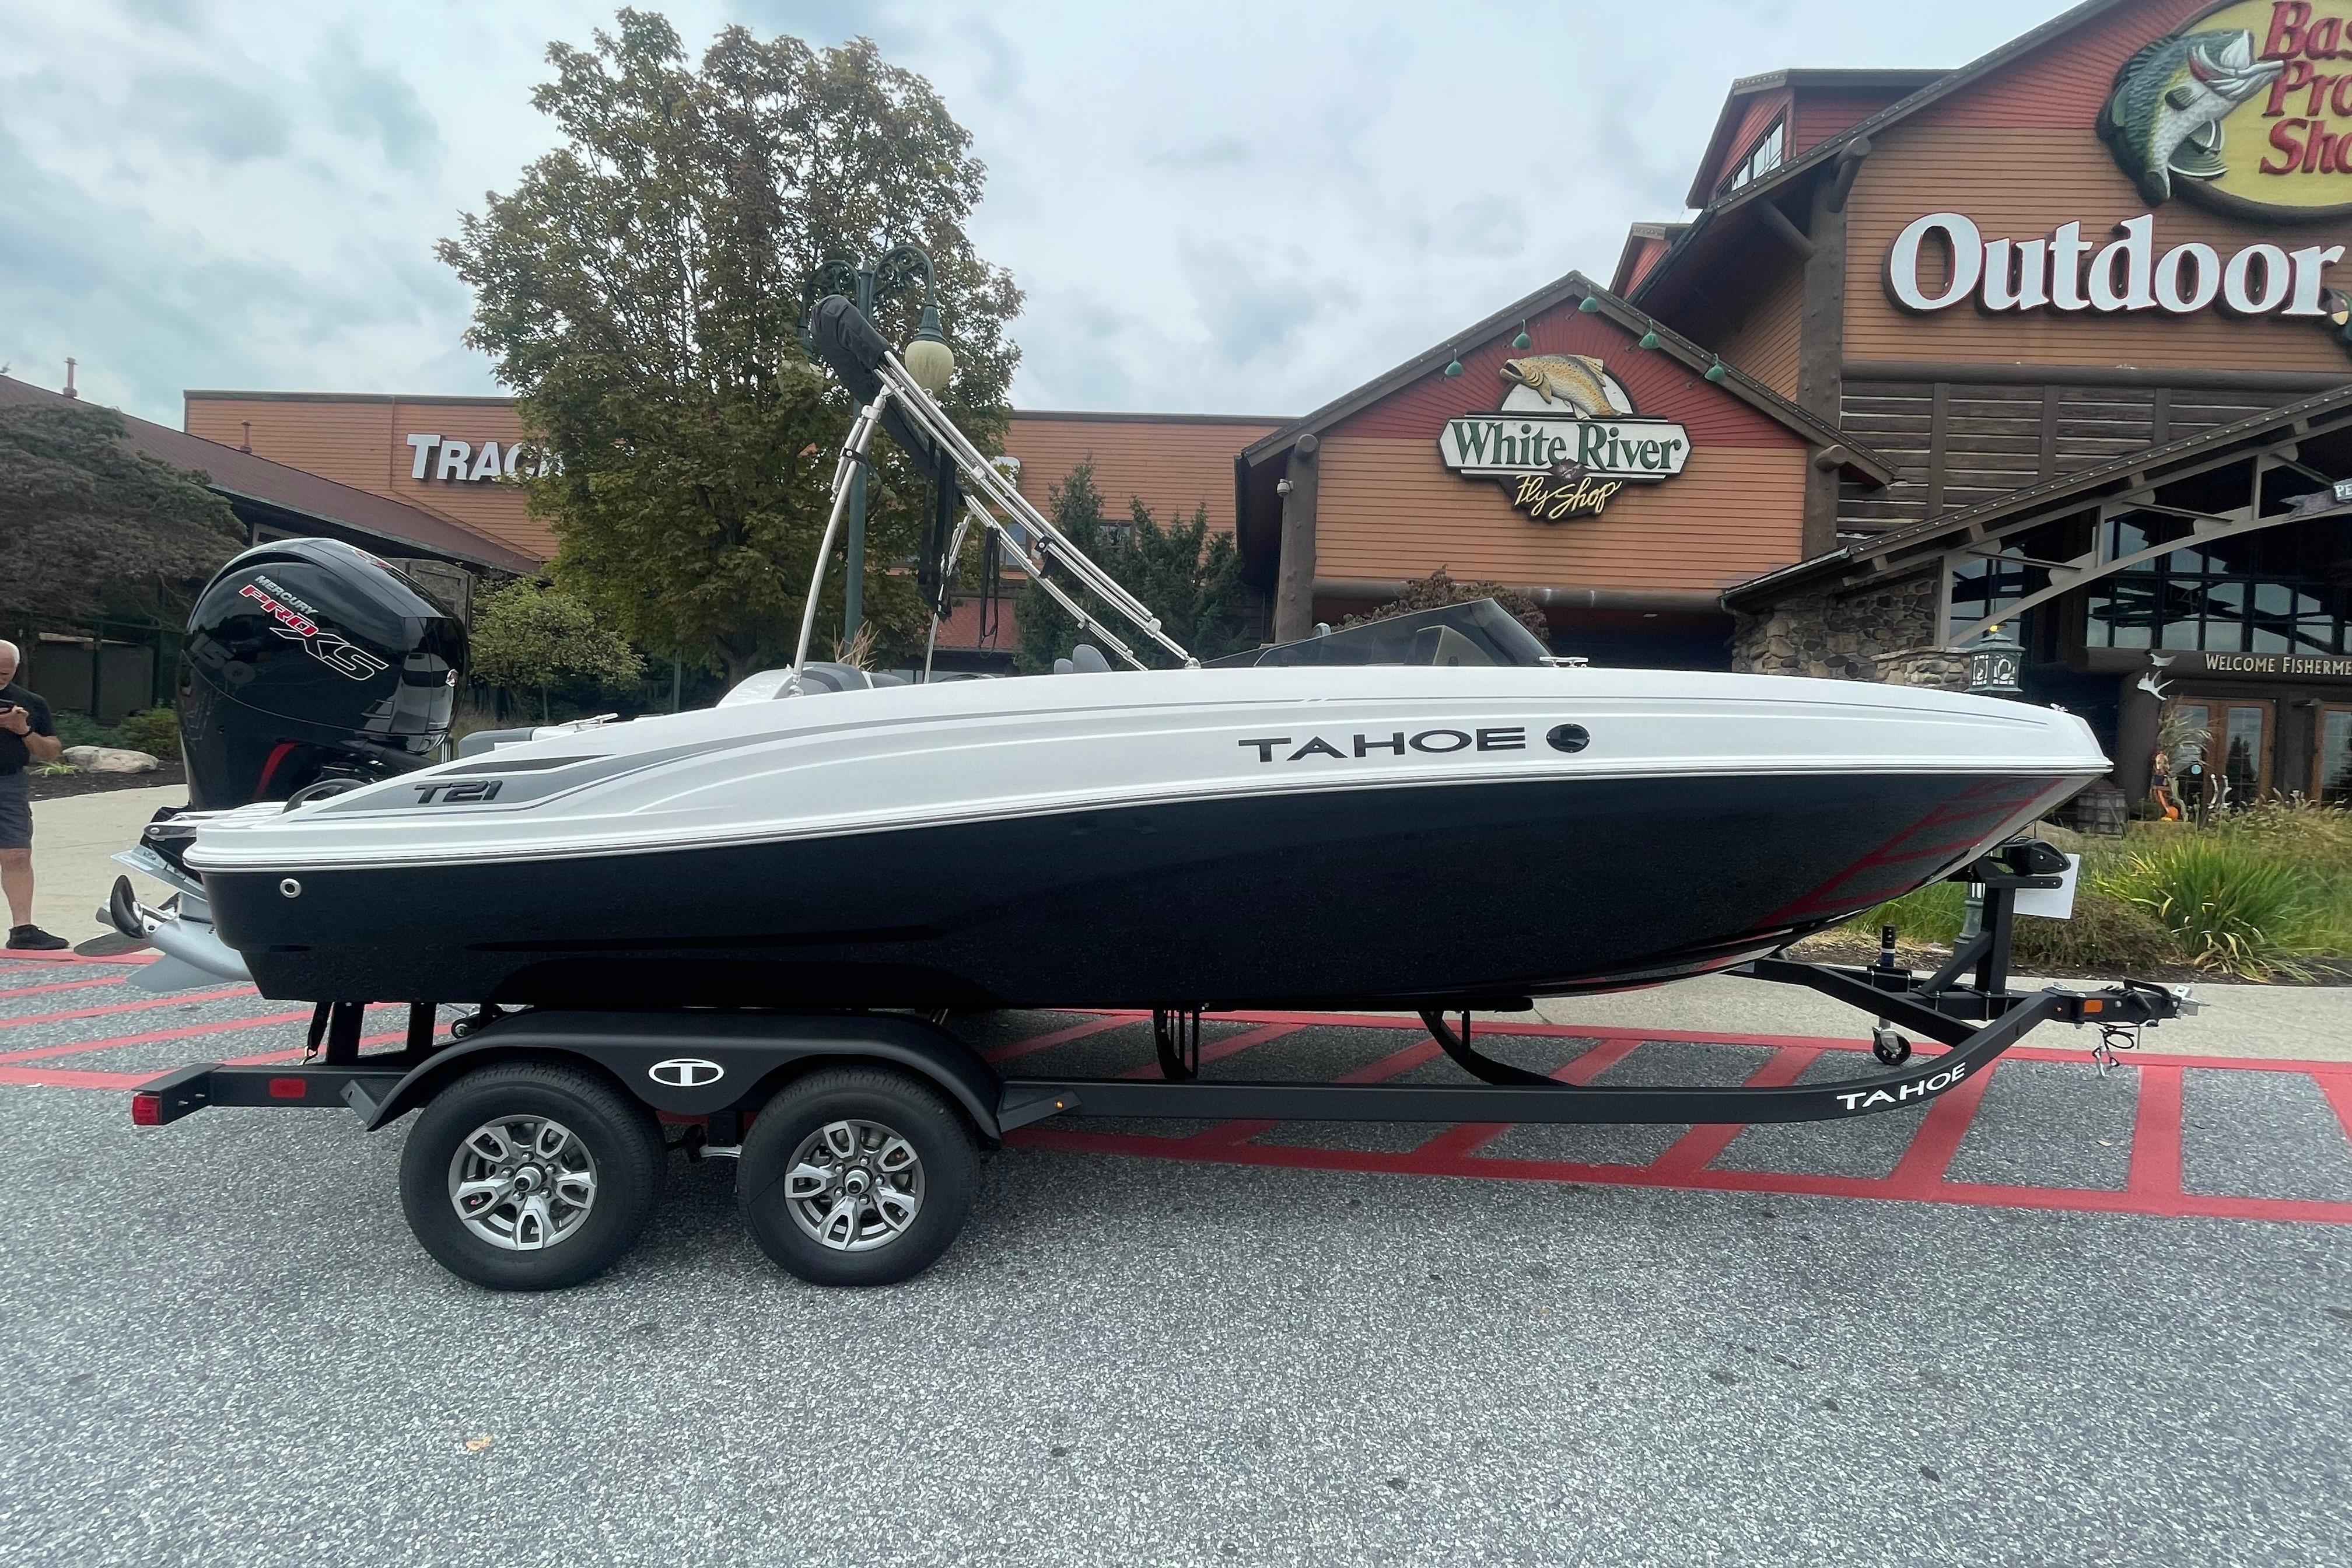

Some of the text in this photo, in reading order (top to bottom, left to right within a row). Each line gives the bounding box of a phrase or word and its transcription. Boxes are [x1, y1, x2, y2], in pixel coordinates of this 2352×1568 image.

[1890, 212, 2346, 316] Outdoor
[1451, 421, 1682, 471] White River
[1514, 474, 1623, 520] Fly Shop
[239, 584, 320, 637] PRO
[254, 575, 319, 615] MERCURY
[269, 626, 390, 681] XS
[2205, 653, 2276, 672] WELCOME
[1238, 726, 1526, 763] TAHOE
[414, 780, 503, 804] T21
[1836, 1062, 1966, 1110] TAHOE
